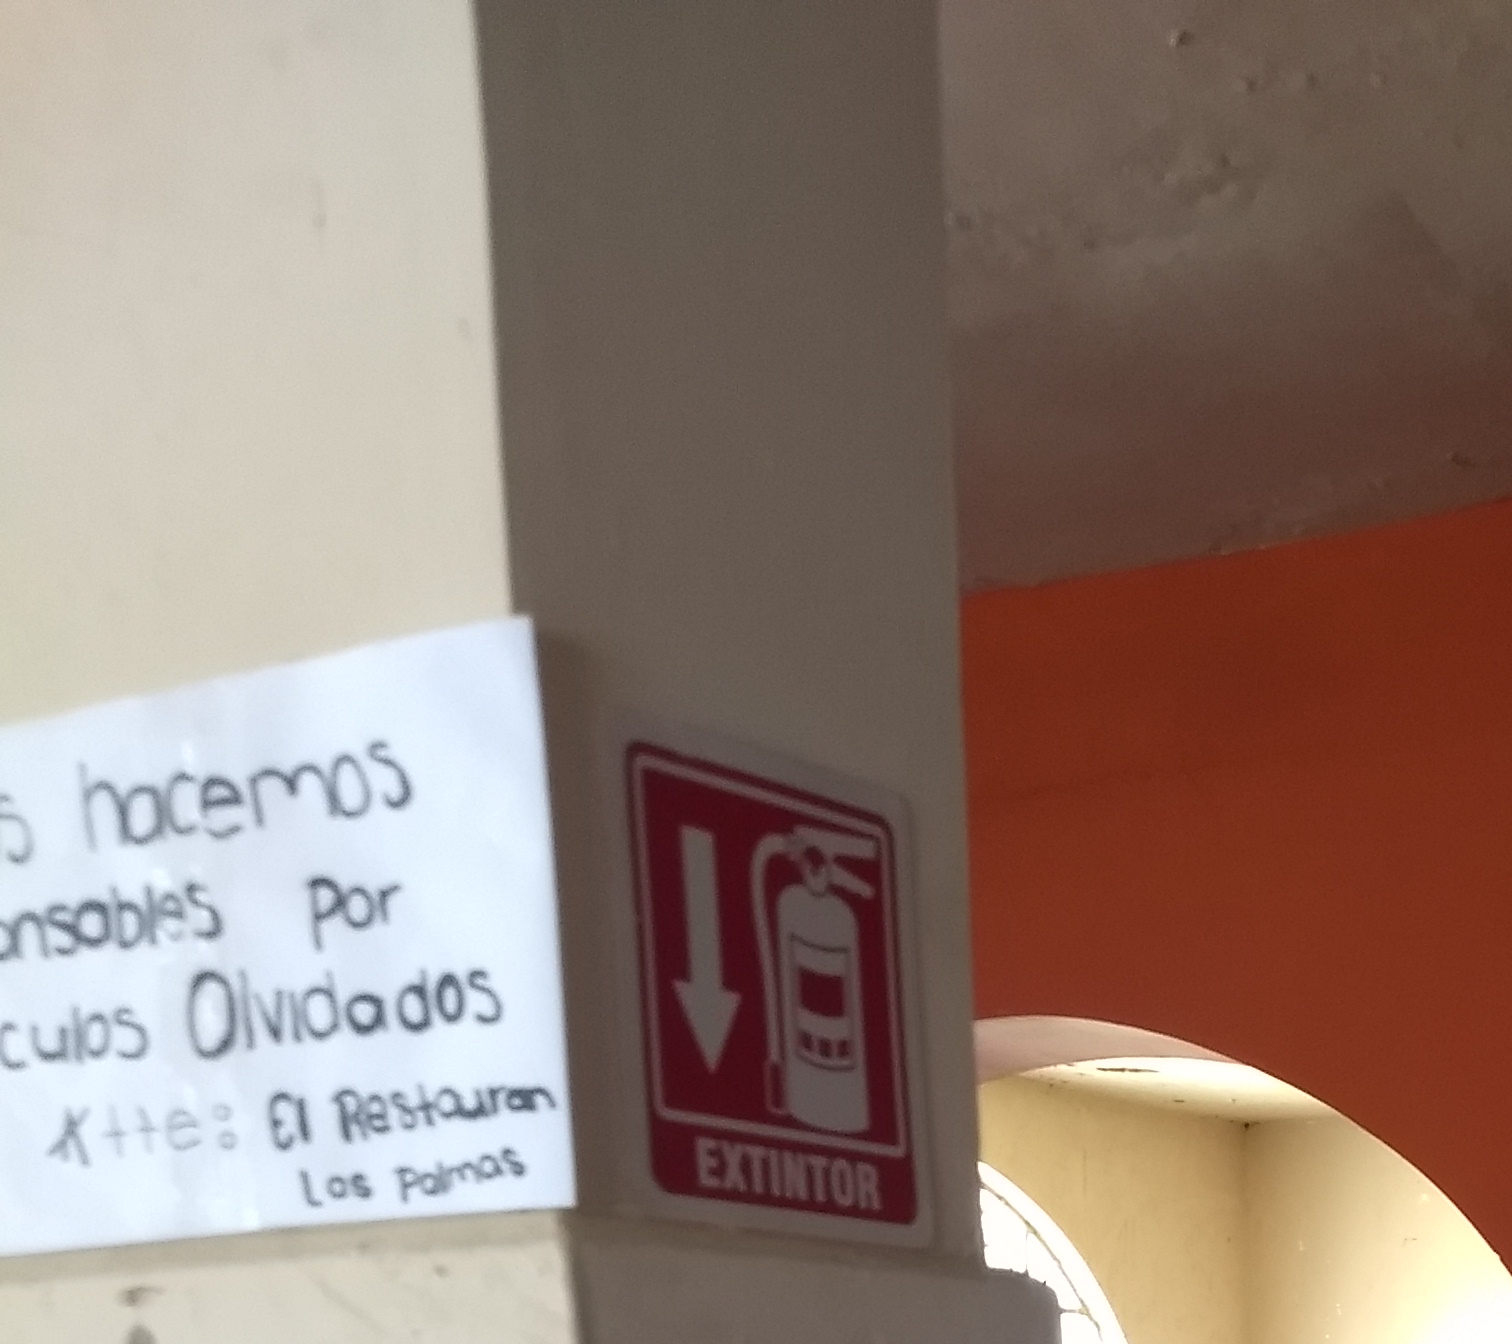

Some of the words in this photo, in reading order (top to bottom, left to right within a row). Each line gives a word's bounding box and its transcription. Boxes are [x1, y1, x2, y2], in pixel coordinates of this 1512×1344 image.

[77, 740, 414, 851] hacemos
[186, 968, 503, 1060] Olvidados
[268, 1091, 311, 1151] El
[694, 1135, 882, 1211] EXTINTOR
